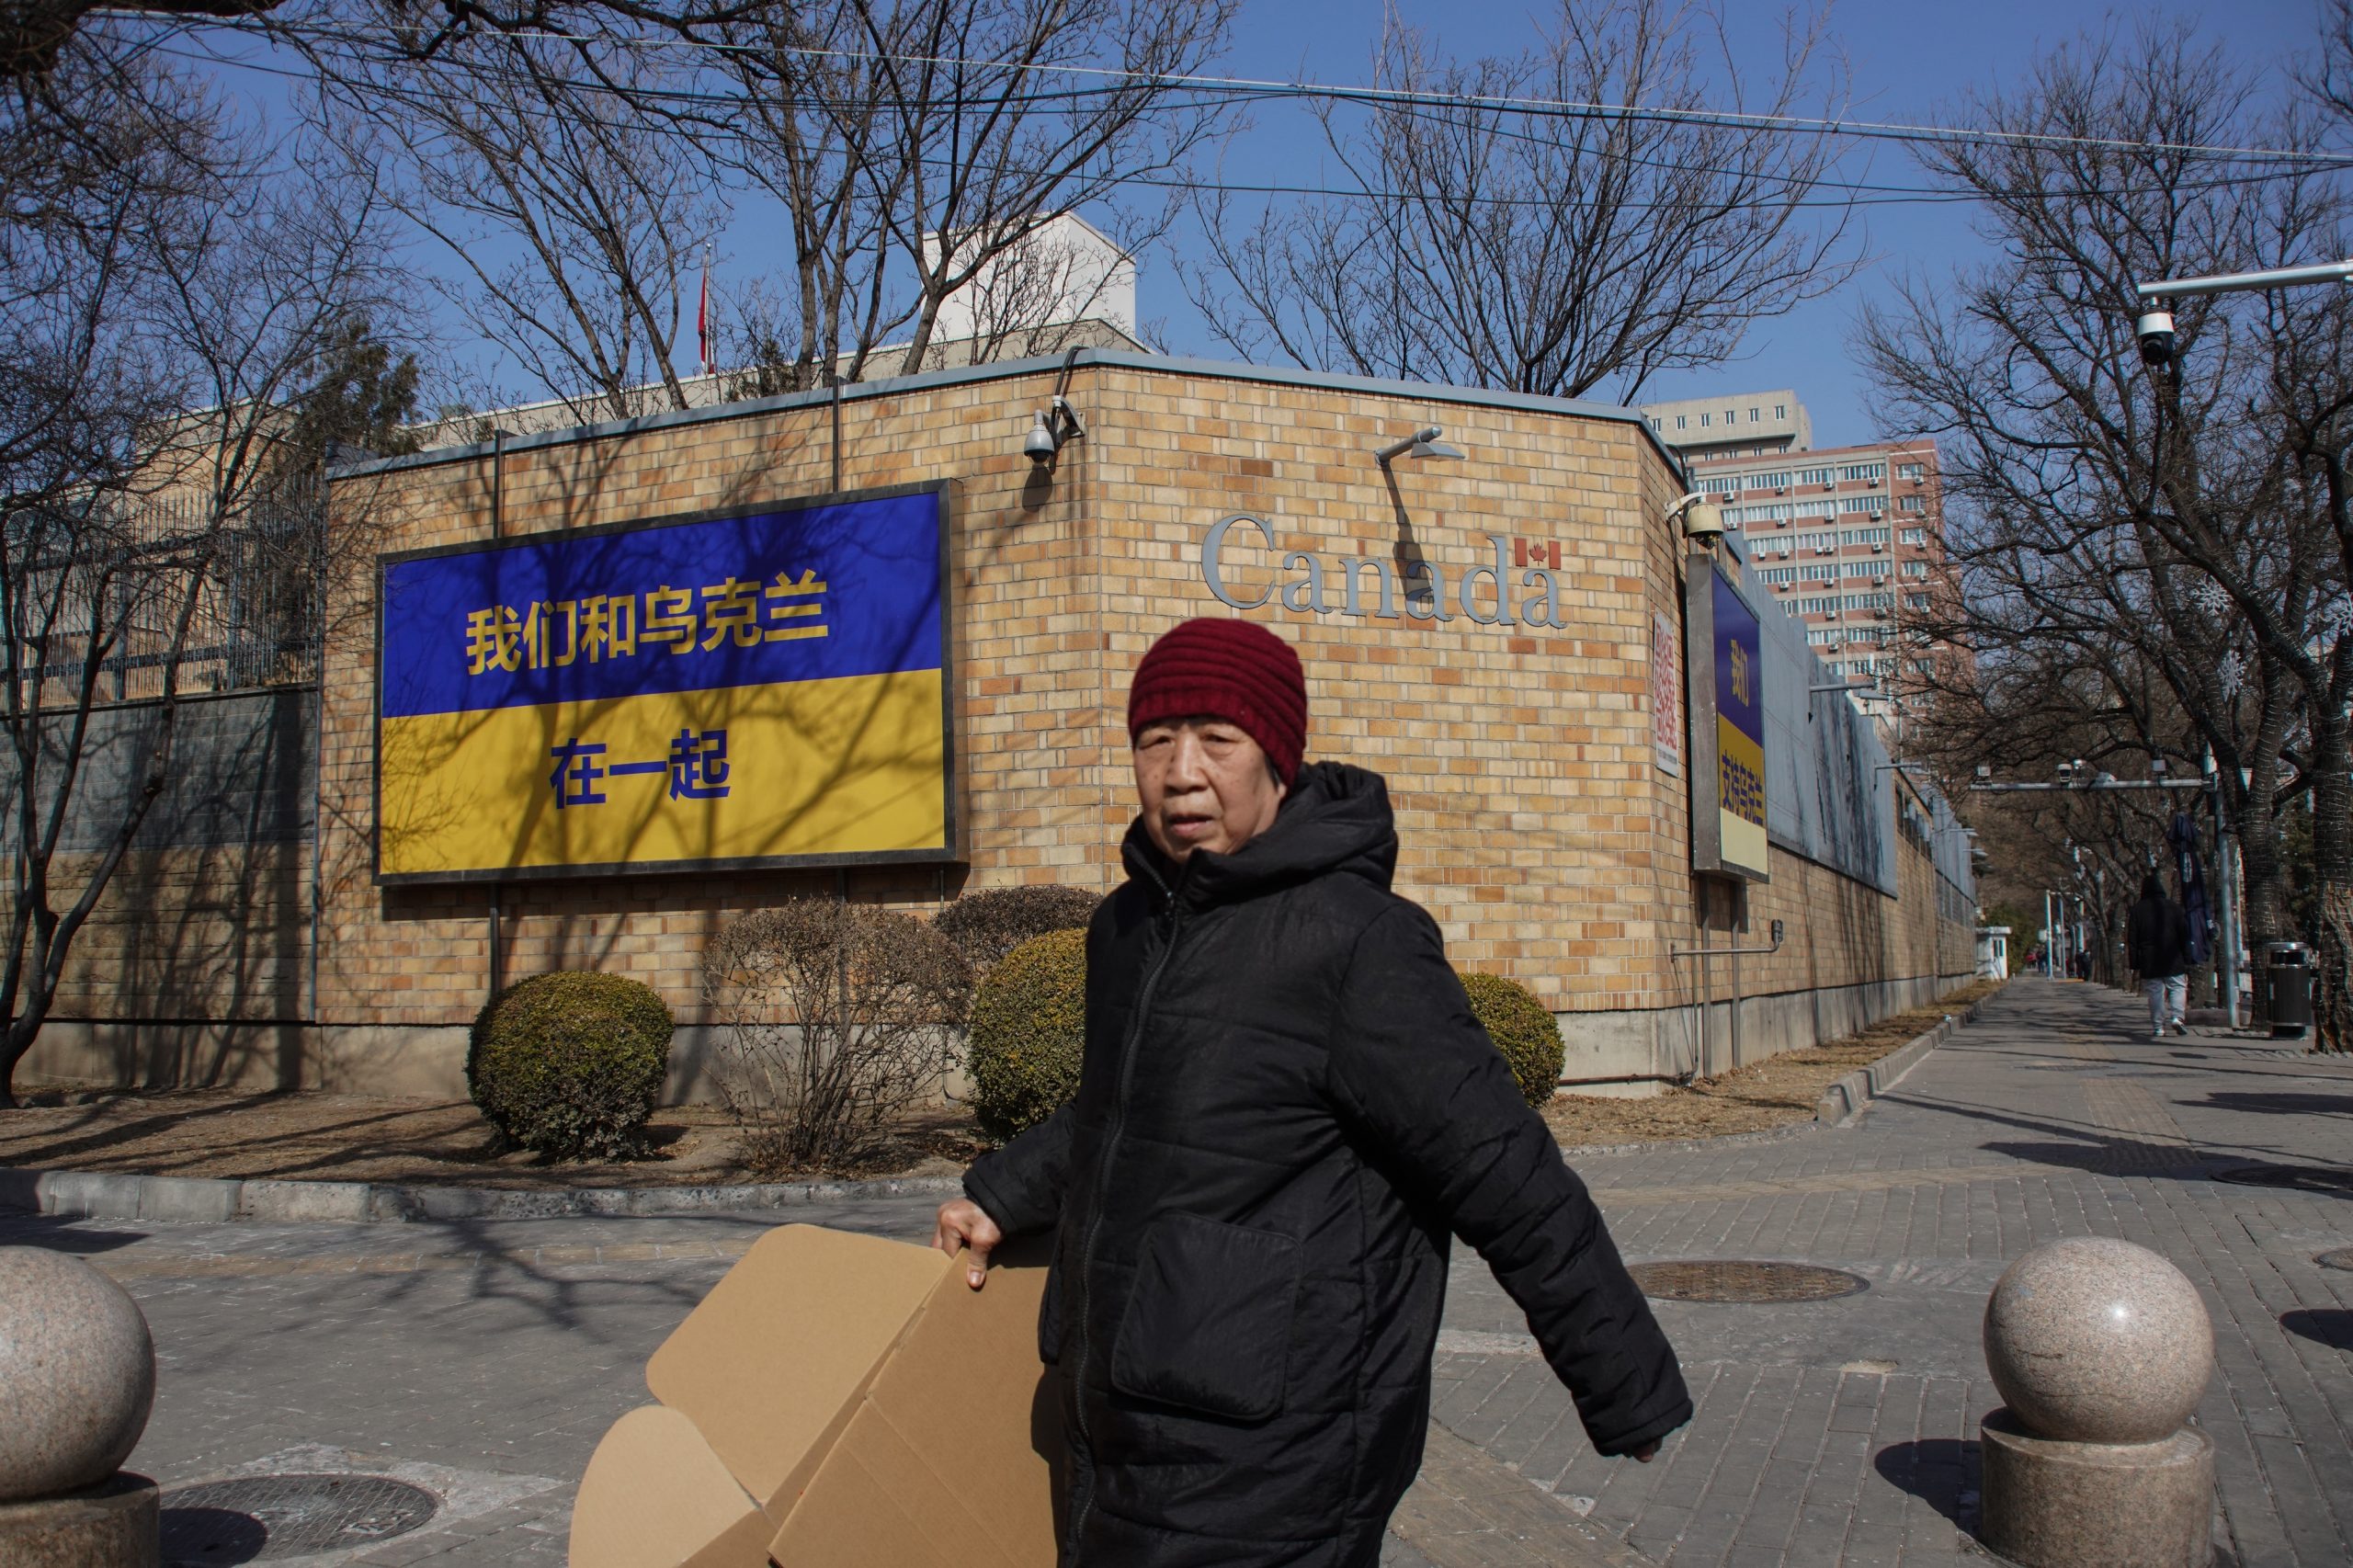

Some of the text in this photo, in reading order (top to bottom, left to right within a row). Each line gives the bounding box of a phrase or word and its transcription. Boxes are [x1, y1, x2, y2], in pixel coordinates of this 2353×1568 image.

[1201, 514, 1567, 629] Canada
[466, 568, 829, 676] 我们和乌克兰
[1731, 639, 1749, 707] 我们
[550, 728, 731, 810] 在一起
[1722, 749, 1764, 827] 支持乌克兰
